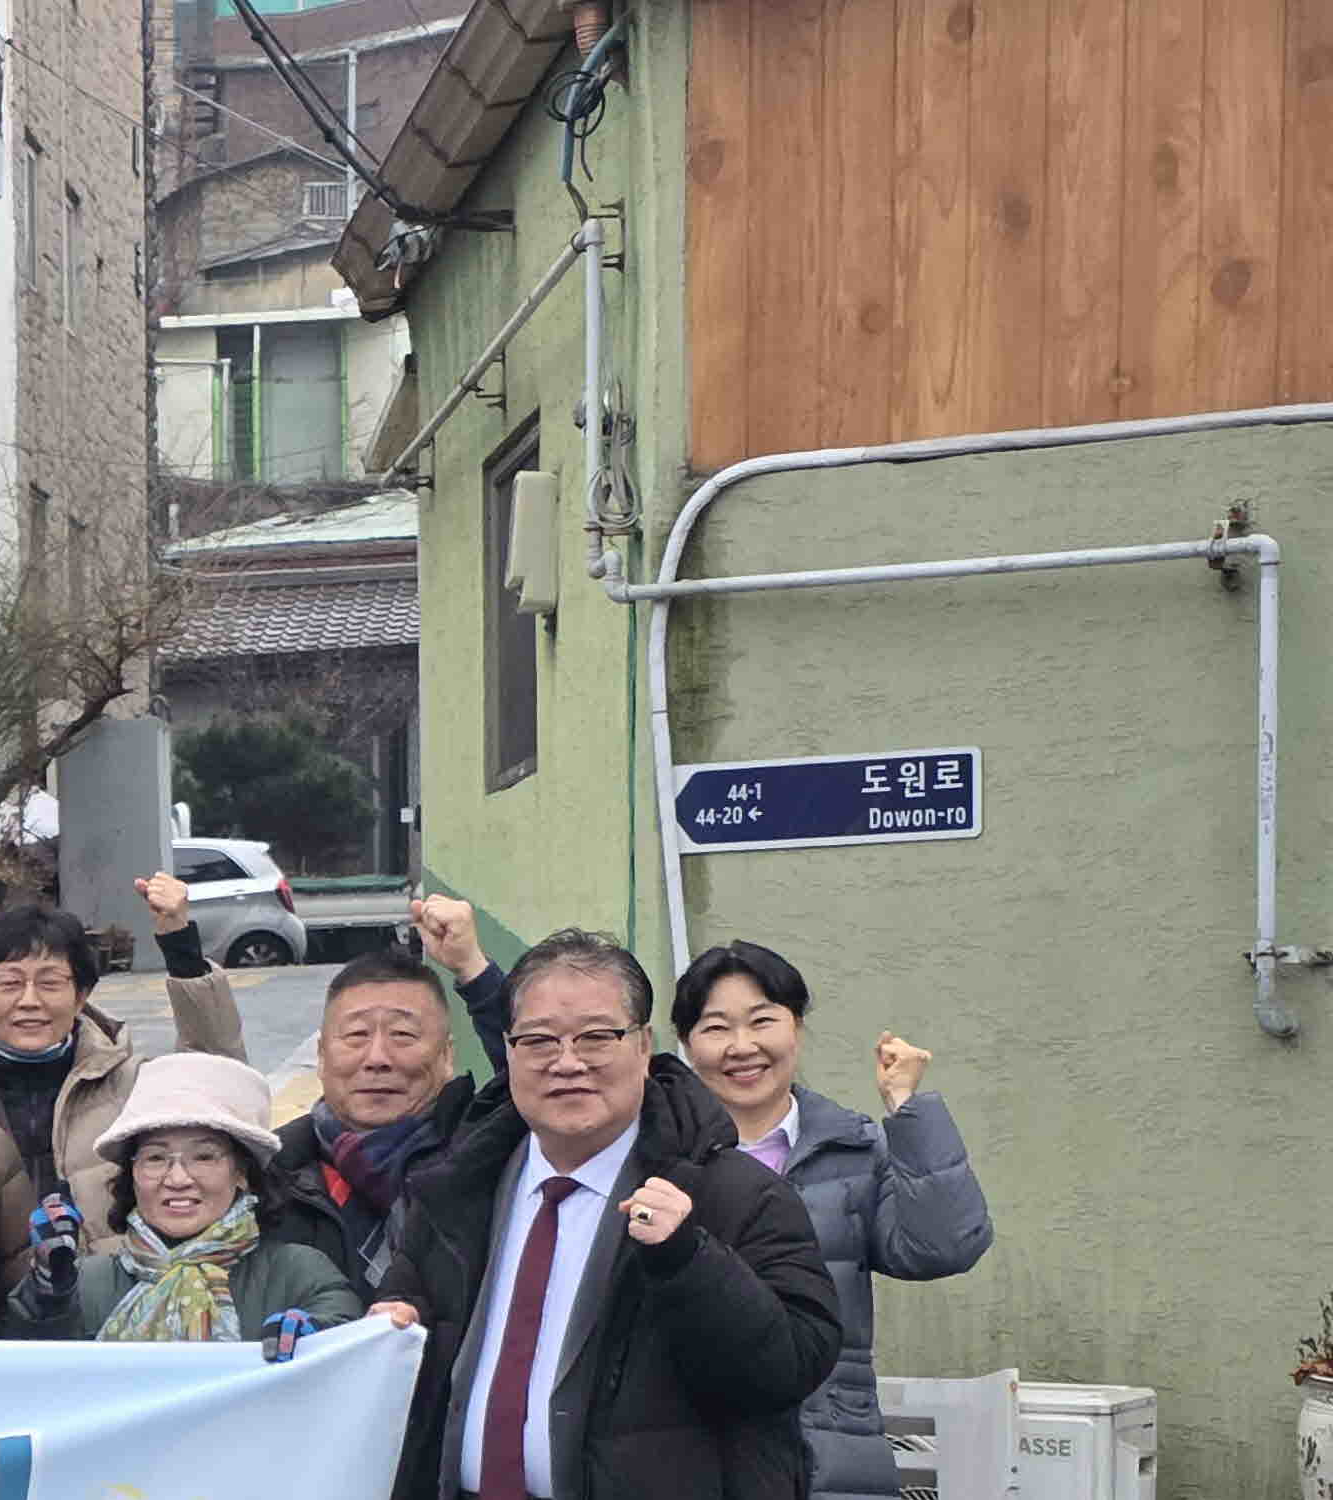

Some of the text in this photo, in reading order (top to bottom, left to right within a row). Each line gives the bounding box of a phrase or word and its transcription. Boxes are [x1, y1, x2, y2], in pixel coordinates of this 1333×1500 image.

[861, 760, 964, 798] 도원로
[727, 783, 762, 801] 44-1
[695, 806, 743, 826] 44-20
[869, 806, 966, 829] Dowon-ro
